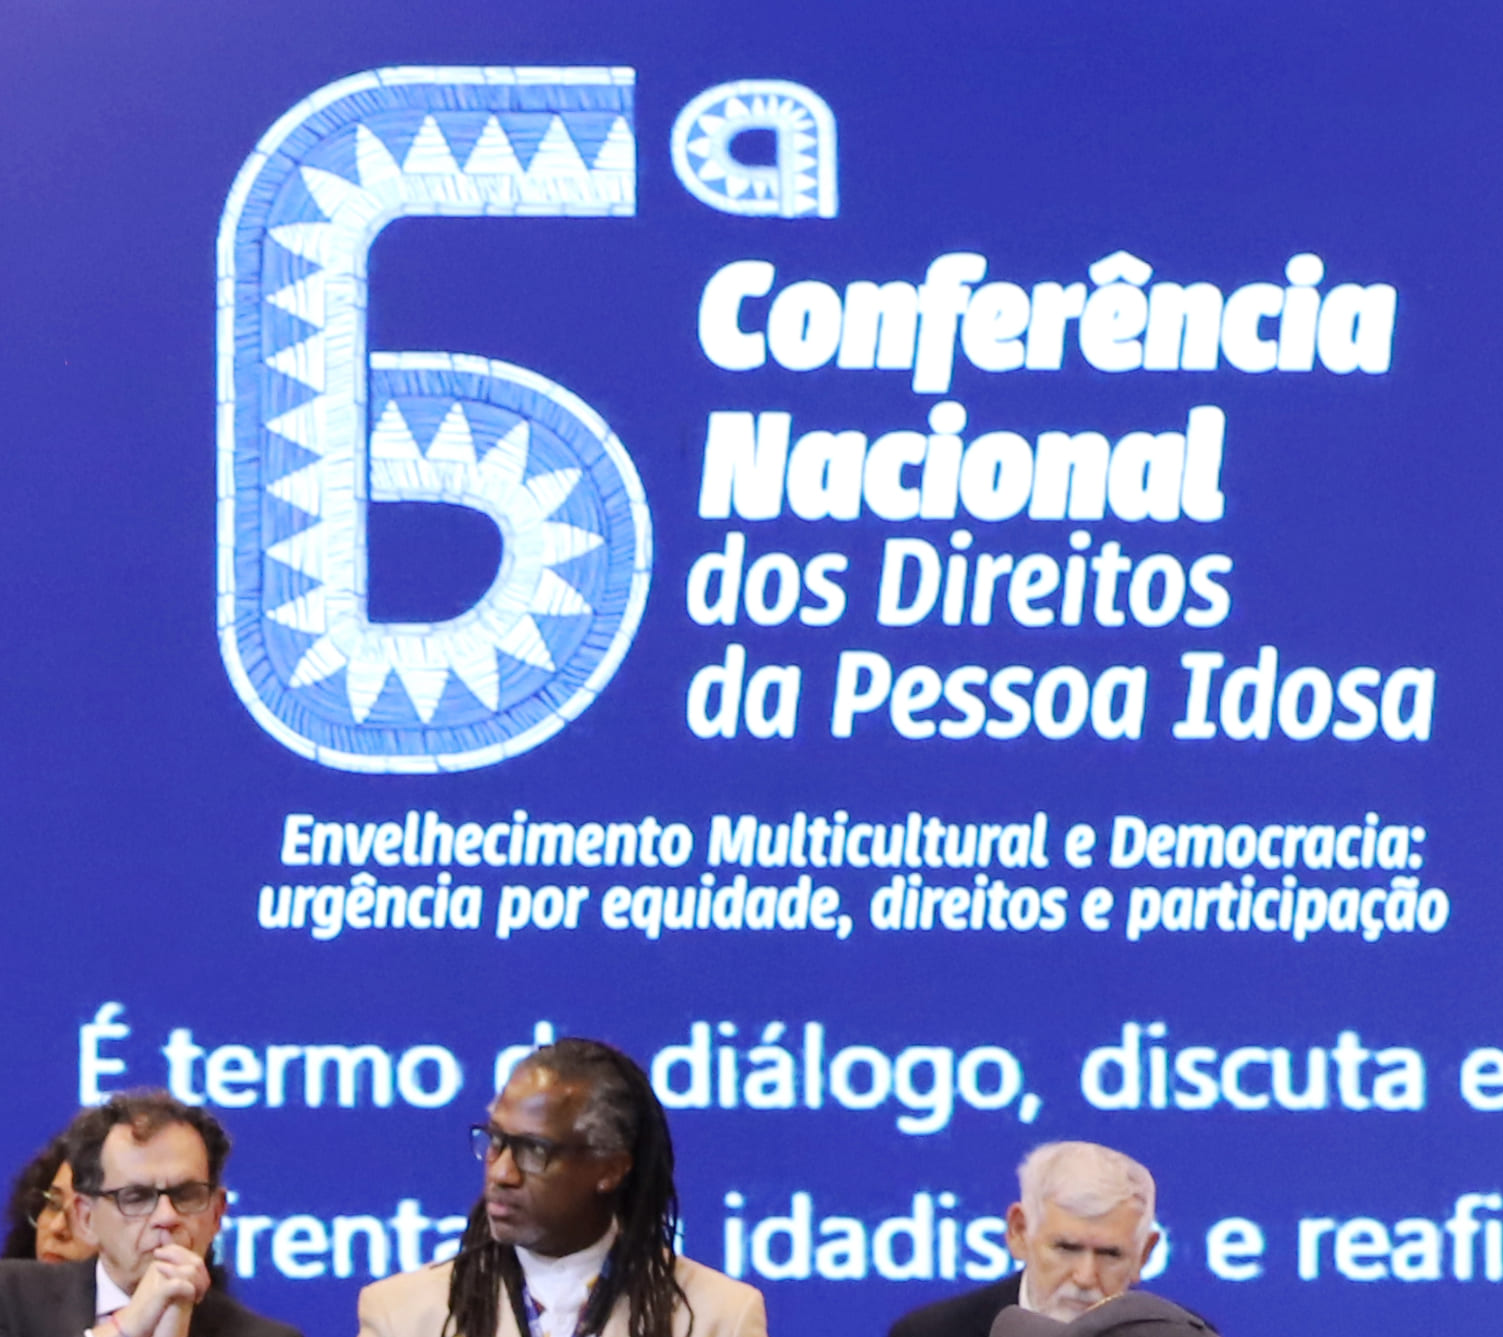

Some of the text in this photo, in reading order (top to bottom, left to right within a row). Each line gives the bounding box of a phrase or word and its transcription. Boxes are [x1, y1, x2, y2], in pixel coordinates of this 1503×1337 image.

[697, 250, 1398, 393] Conferência
[698, 402, 1226, 522] Nacional
[687, 530, 1233, 628] dos Direitos
[687, 644, 1435, 741] da Pessoa Idosa
[281, 812, 1426, 870] Envelhecimento Multicultural e Democracia:
[258, 872, 1449, 943] urgência por equidade, direitos e participação
[79, 1001, 131, 1102] É
[161, 1027, 463, 1108] termo
[651, 1020, 1042, 1135] diálogo,
[1080, 1021, 1425, 1111] discuta
[1206, 1217, 1265, 1281] e
